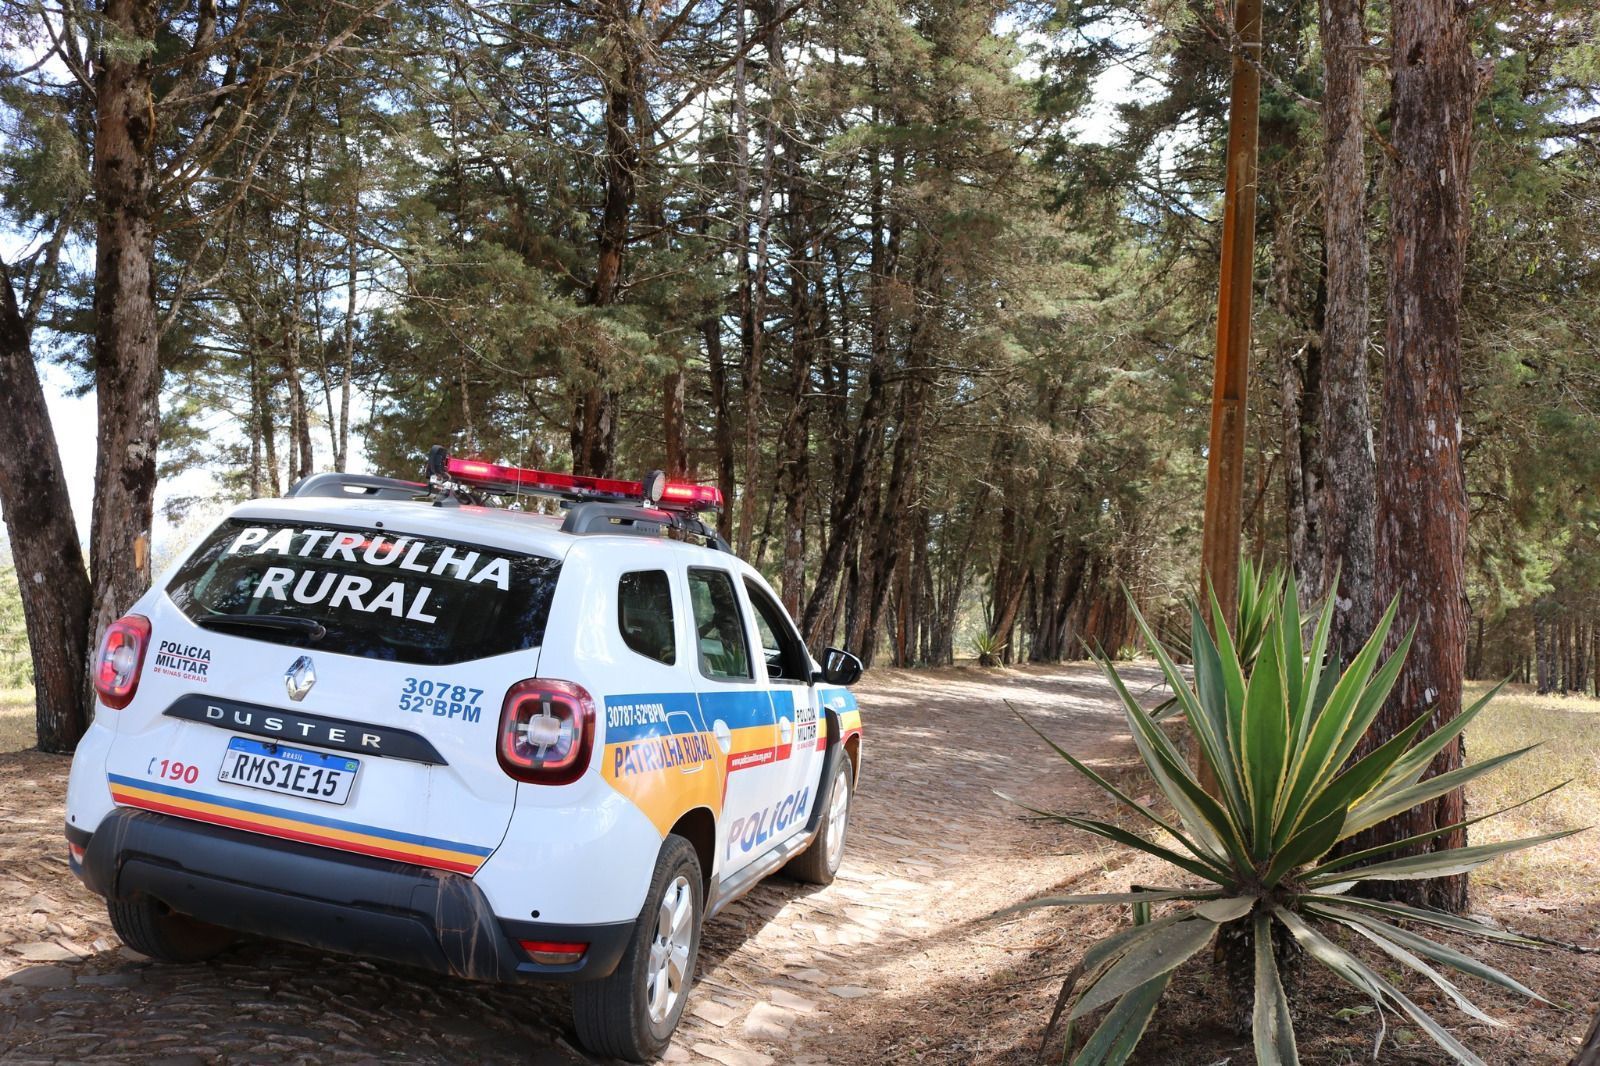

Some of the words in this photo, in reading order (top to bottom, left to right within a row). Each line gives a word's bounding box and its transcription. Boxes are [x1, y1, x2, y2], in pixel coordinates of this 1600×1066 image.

[227, 527, 511, 591] PATRULHA
[252, 566, 438, 624] RURAL
[155, 654, 208, 675] MILITAR
[162, 669, 181, 678] MINAS
[183, 673, 208, 683] GERAIS
[402, 677, 484, 705] 30787
[206, 705, 382, 749] DUSTER
[797, 724, 817, 742] MILITAR
[281, 751, 304, 761] BRASIL
[614, 737, 685, 778] PATRULHA
[682, 734, 712, 764] RURAL
[160, 759, 199, 784] 190
[220, 770, 230, 780] BR
[231, 754, 341, 797] RMS1E15
